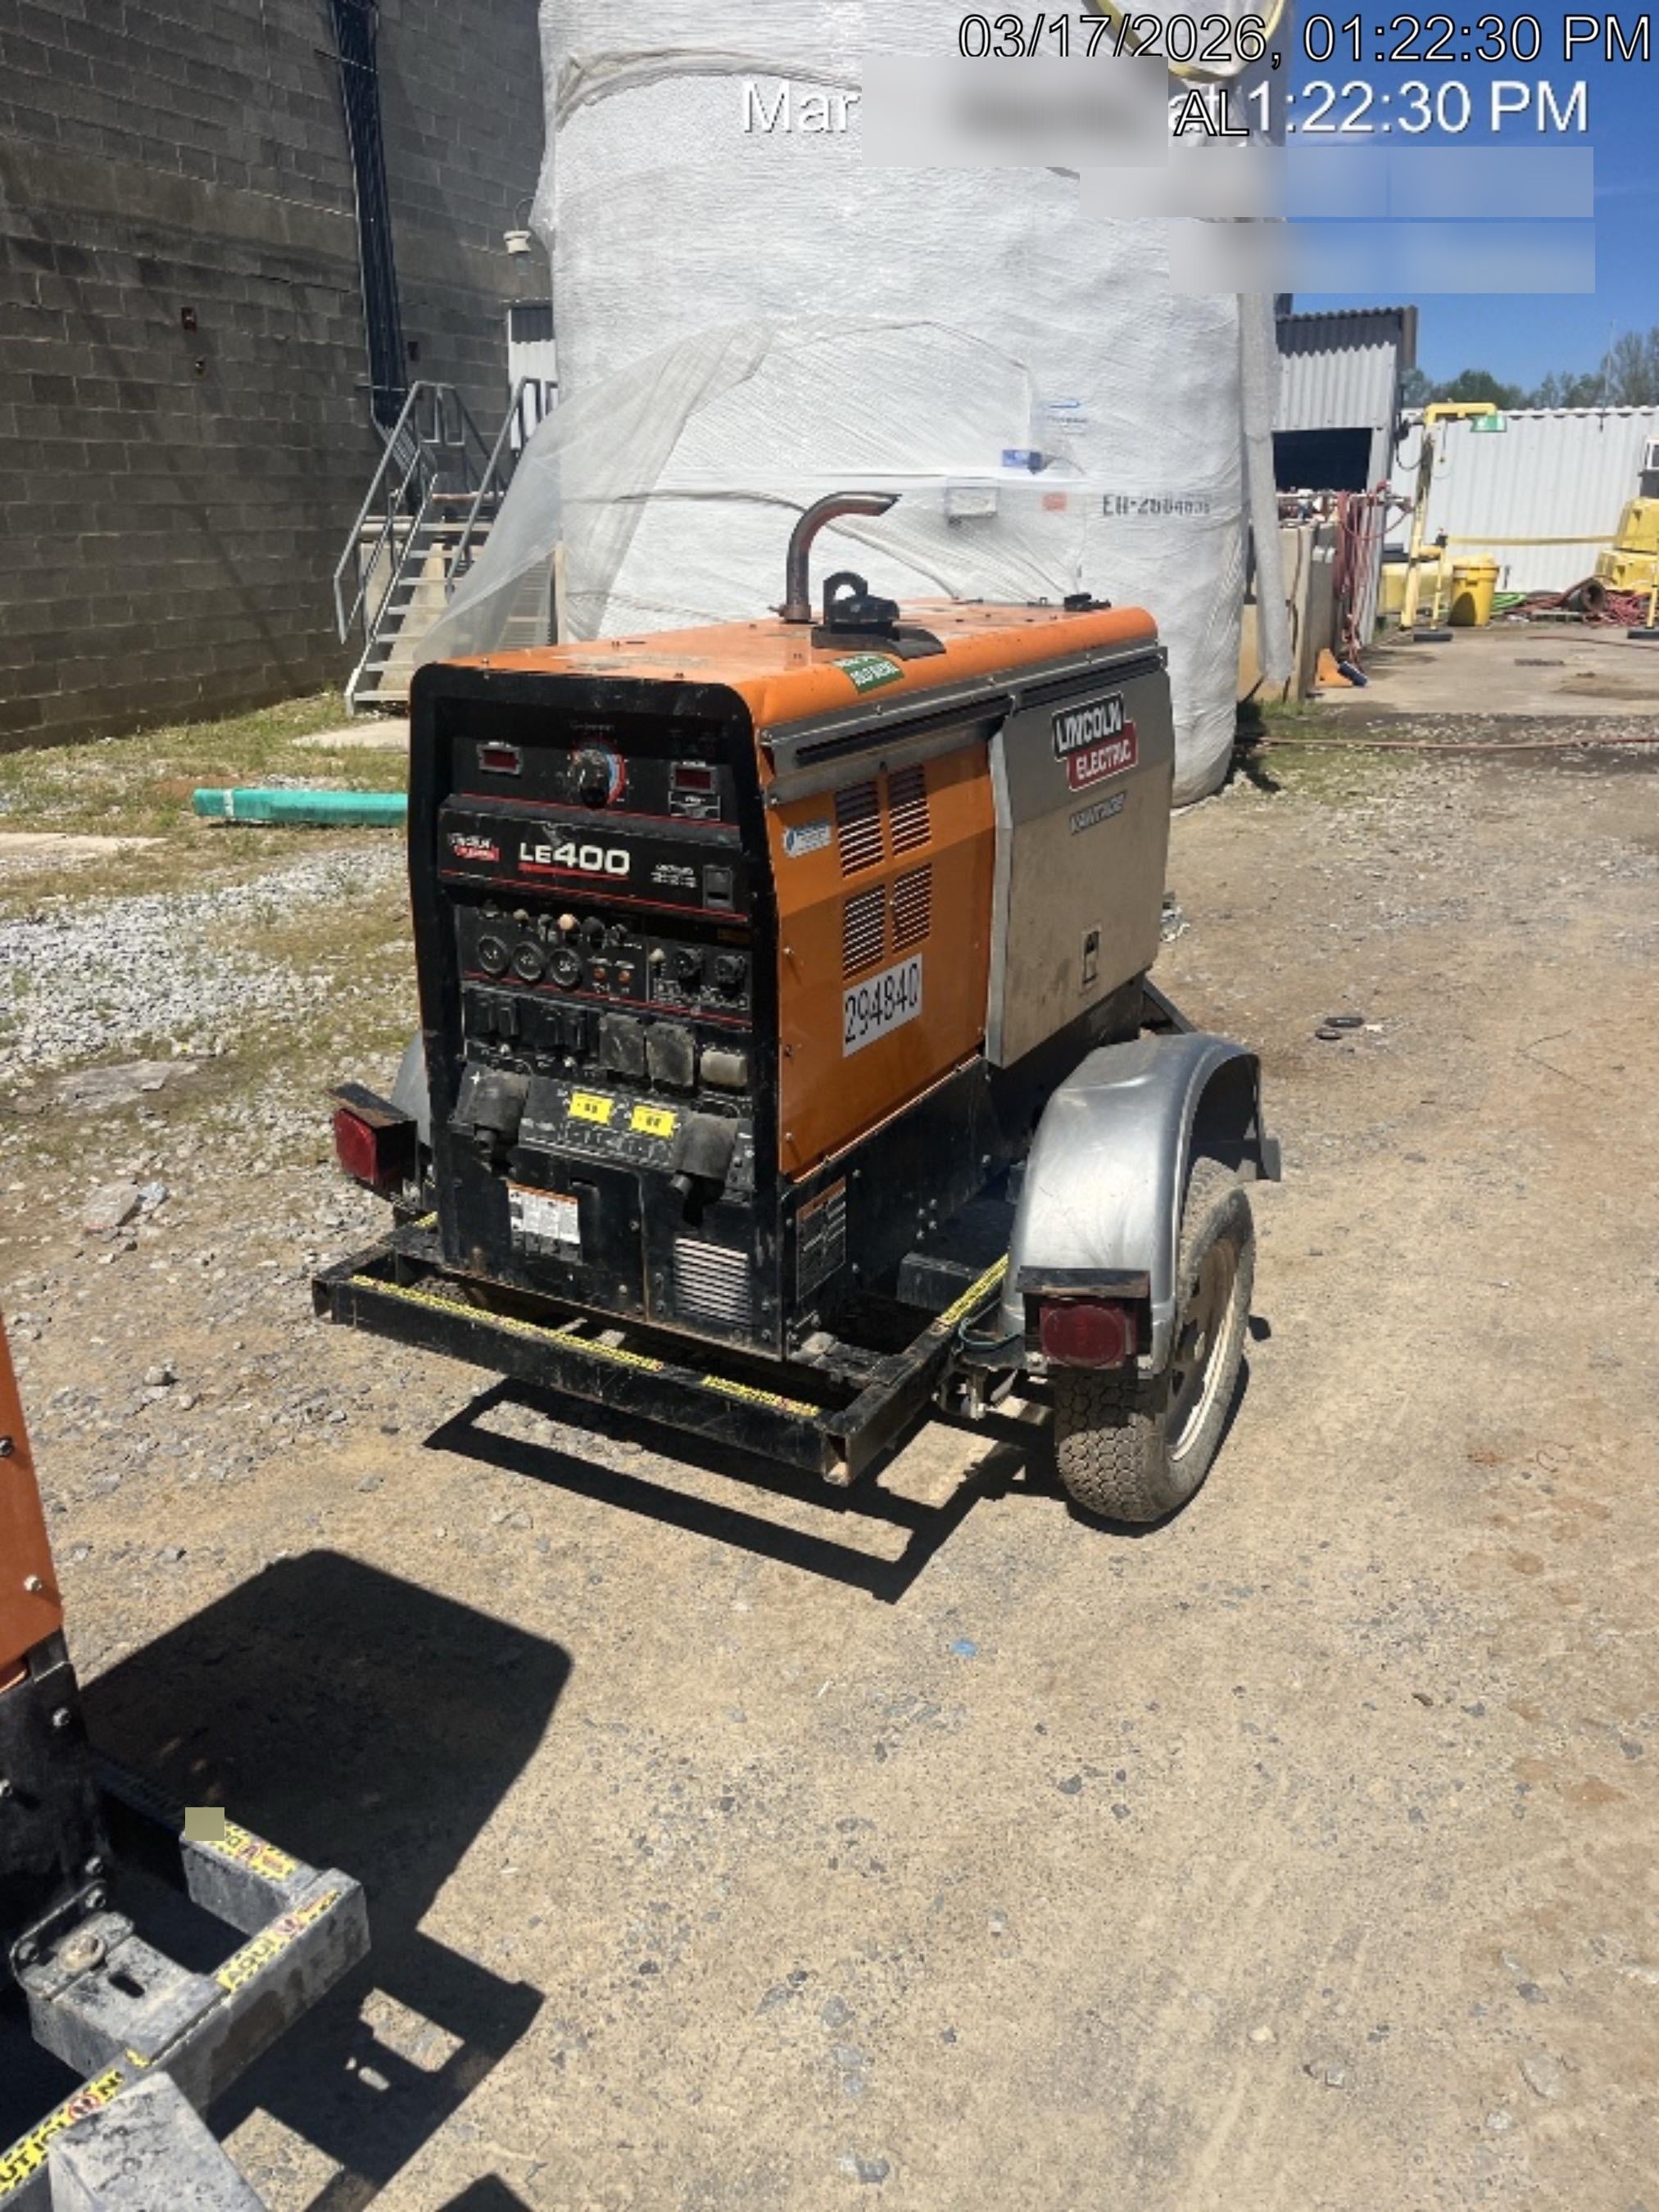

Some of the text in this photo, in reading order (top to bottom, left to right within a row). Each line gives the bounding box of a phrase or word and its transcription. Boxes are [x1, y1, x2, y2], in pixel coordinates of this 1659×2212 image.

[1056, 699, 1122, 753] LINCOLN
[1075, 739, 1131, 781] ELECTRIC
[519, 841, 631, 876] LE400
[845, 963, 920, 1045] 294840
